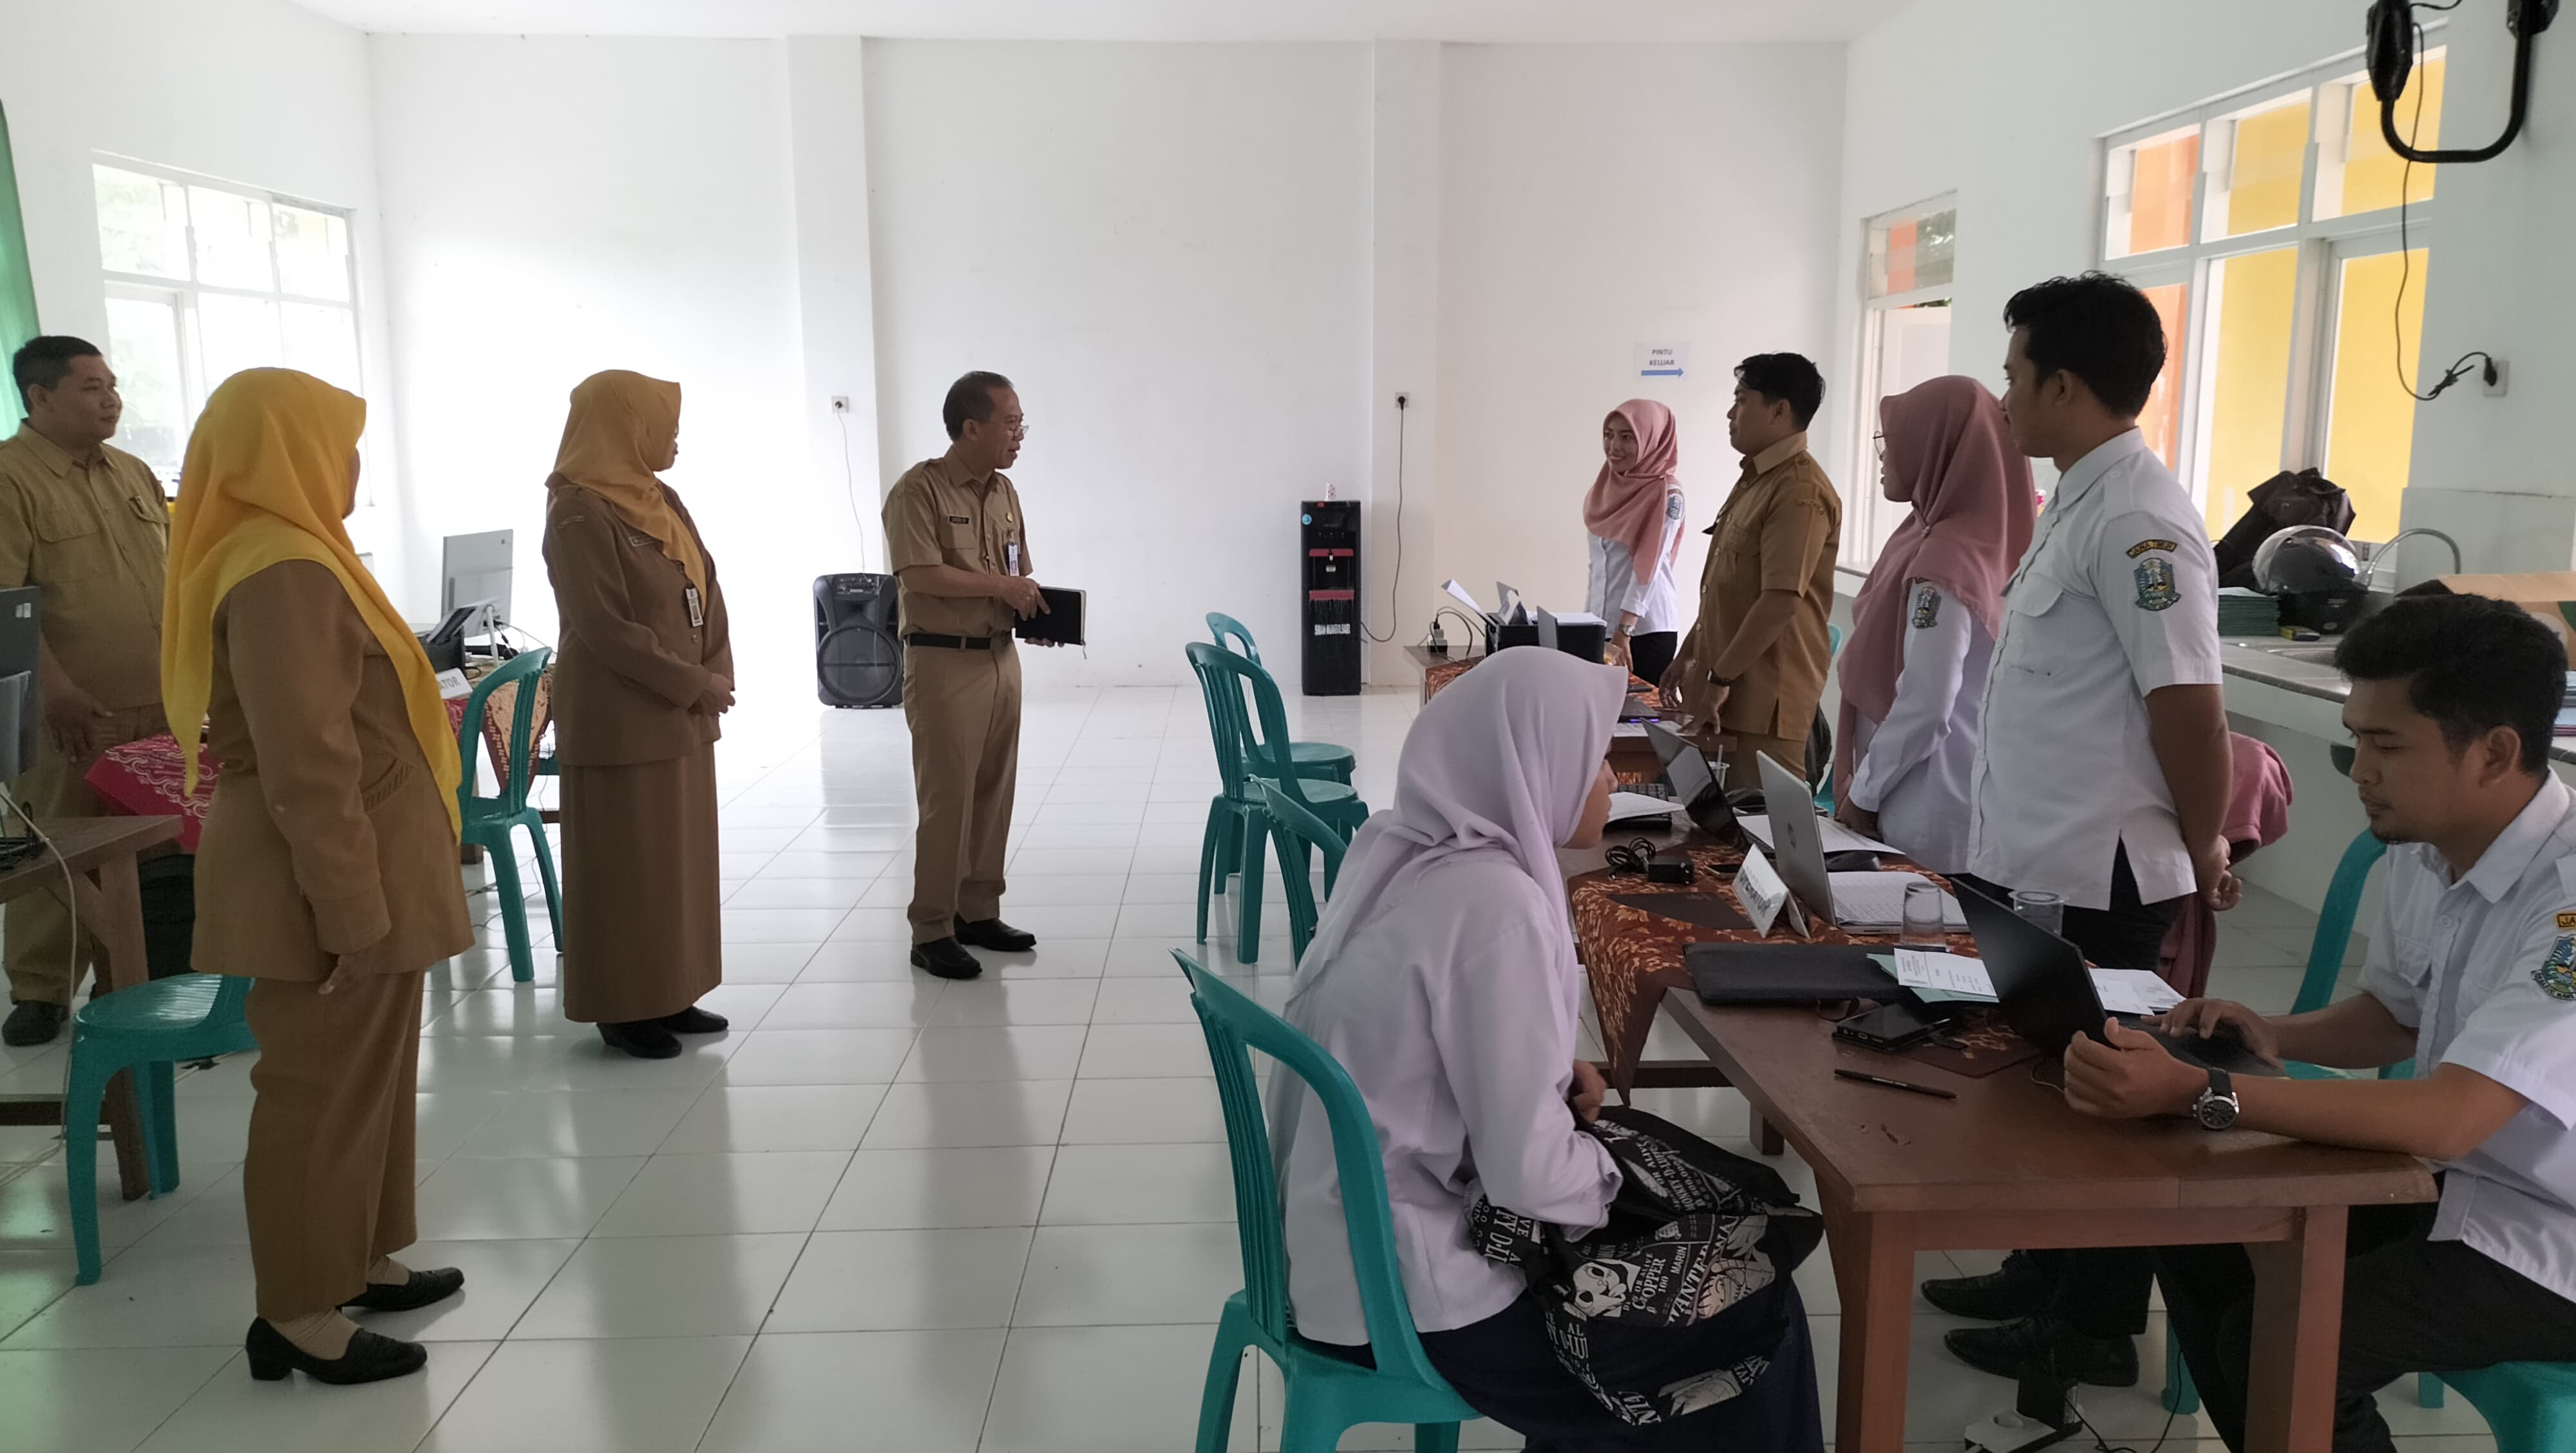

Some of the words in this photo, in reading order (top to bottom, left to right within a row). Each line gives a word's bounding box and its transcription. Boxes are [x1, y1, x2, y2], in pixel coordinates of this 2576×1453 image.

[1640, 1252, 1654, 1277] ALIVE
[1670, 1246, 1687, 1275] MARIN
[1658, 1275, 1669, 1293] 100
